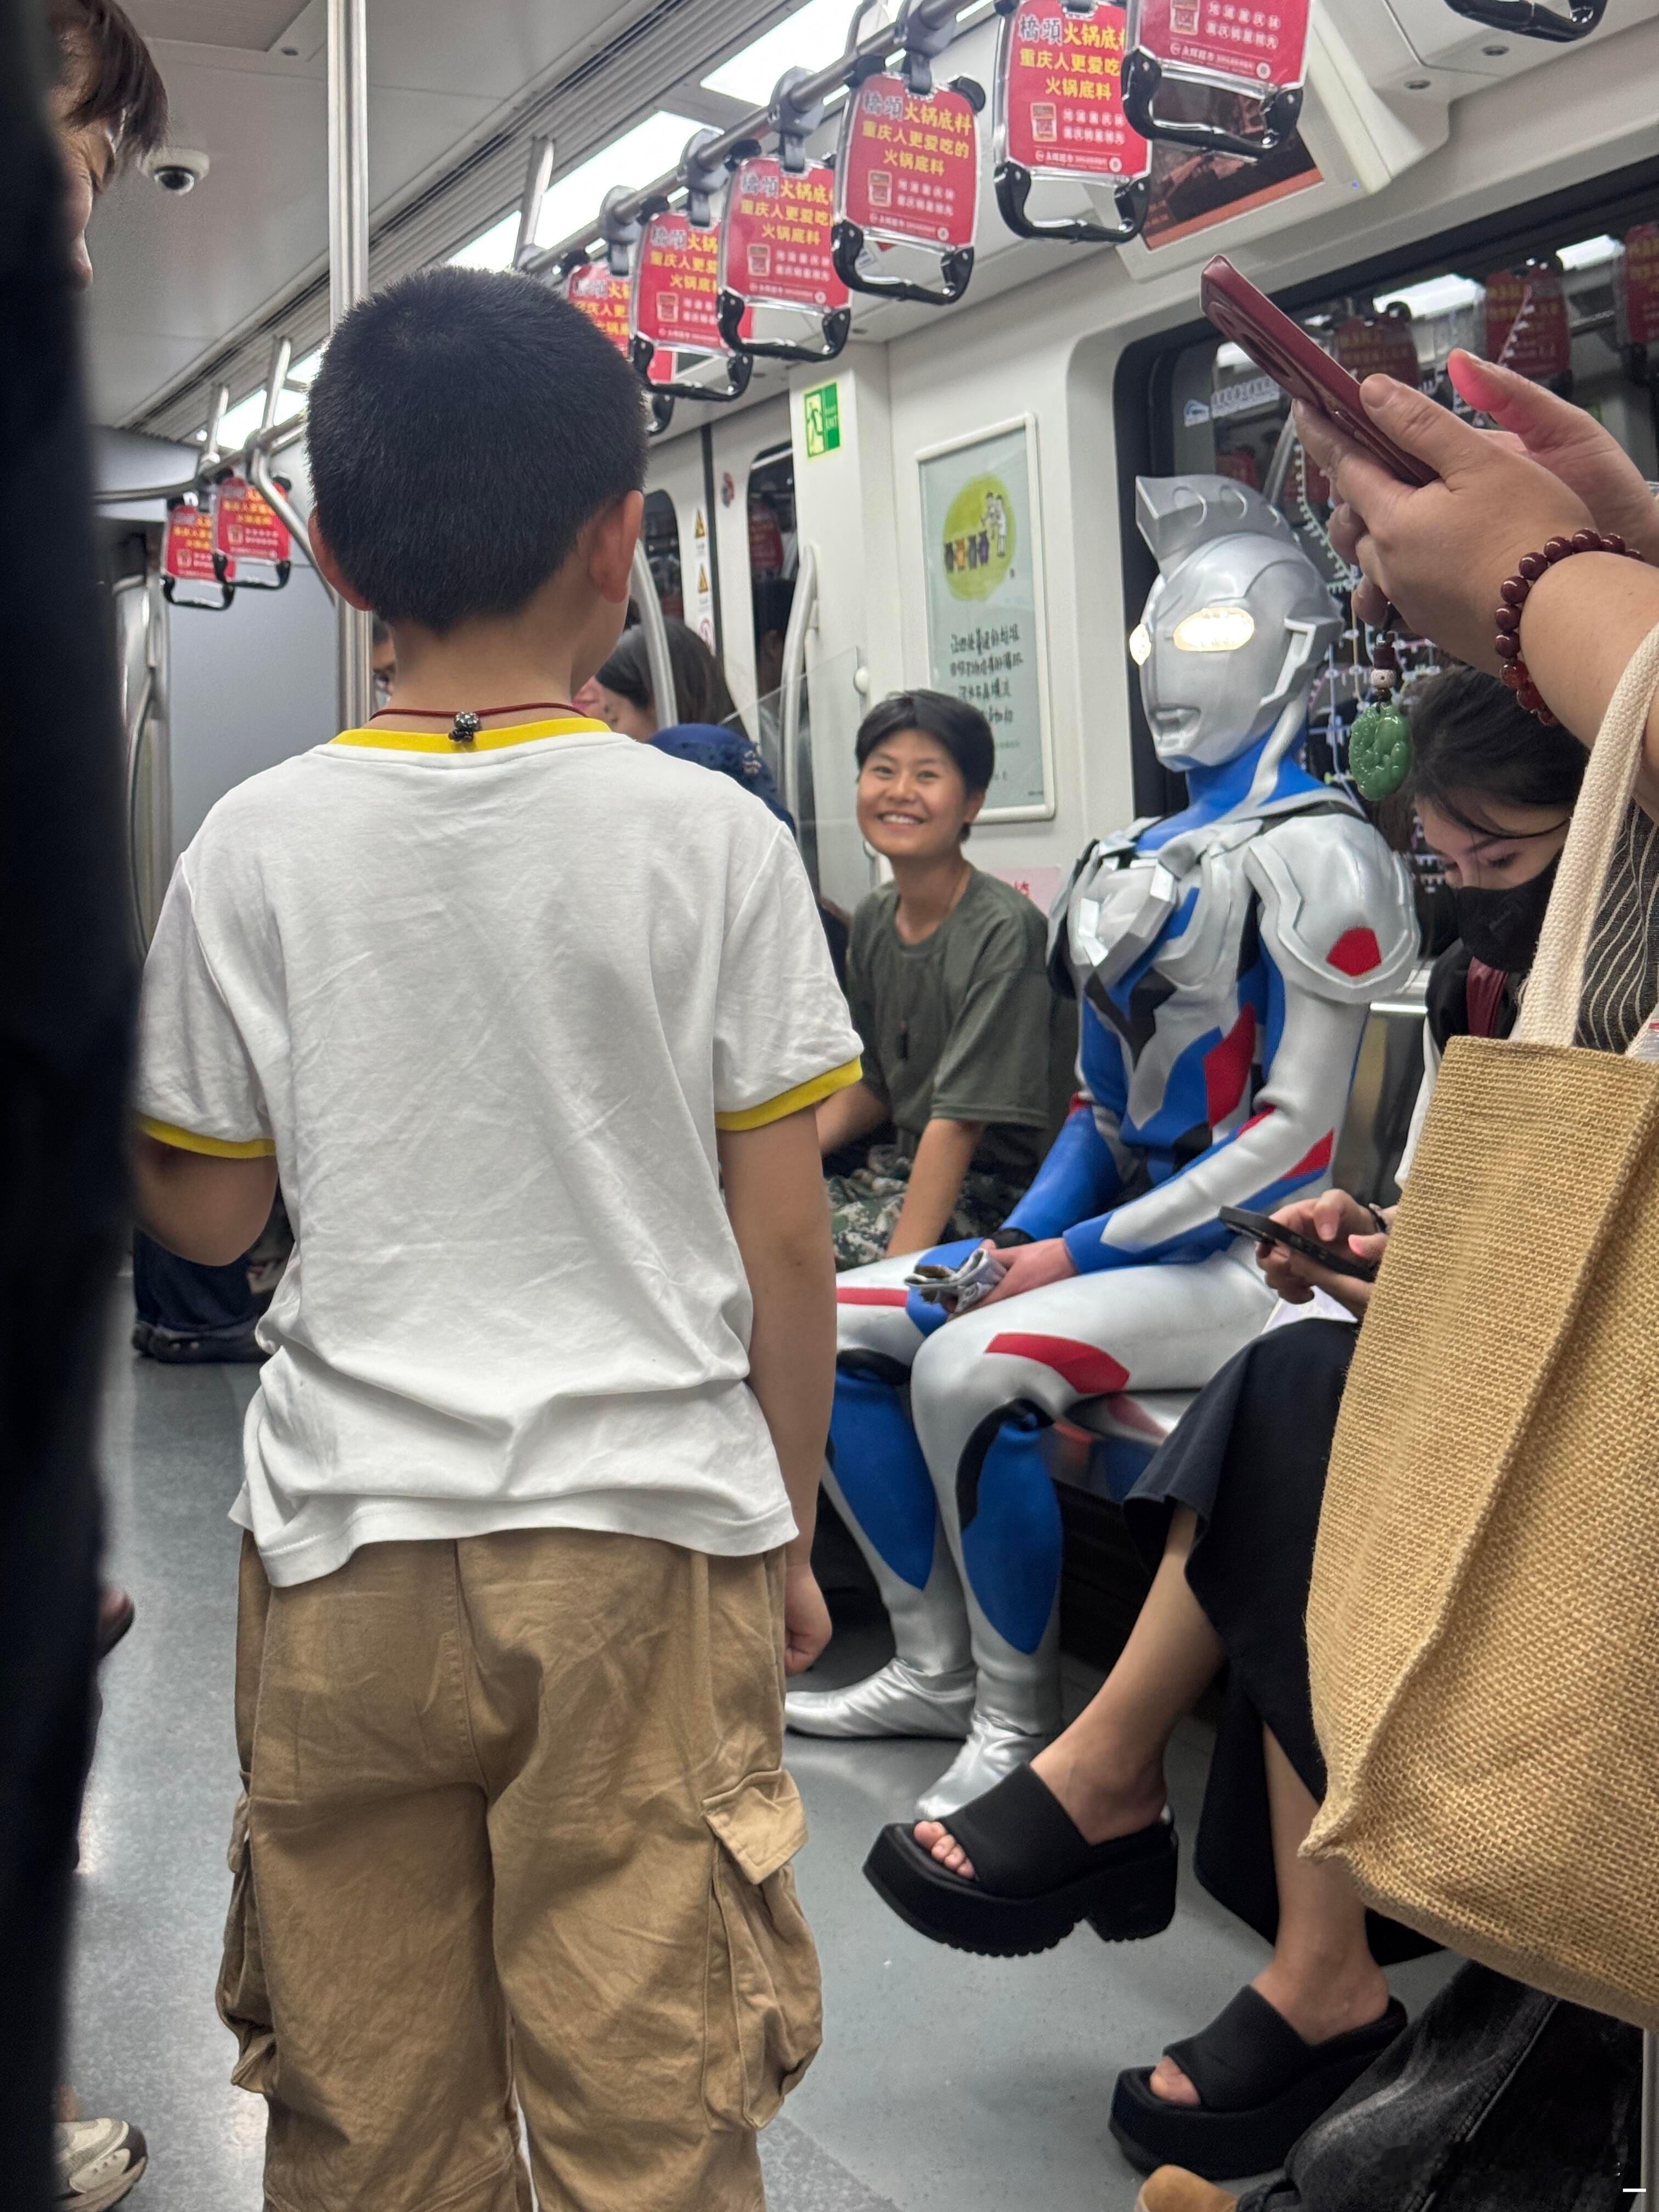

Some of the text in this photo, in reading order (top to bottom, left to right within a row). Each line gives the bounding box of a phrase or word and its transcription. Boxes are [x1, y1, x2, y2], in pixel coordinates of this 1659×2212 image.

[1045, 76, 1112, 101] 火锅底料
[862, 120, 970, 159] 重庆人更爱吃的
[883, 149, 945, 176] 火锅底料
[761, 222, 821, 246] 火锅底料
